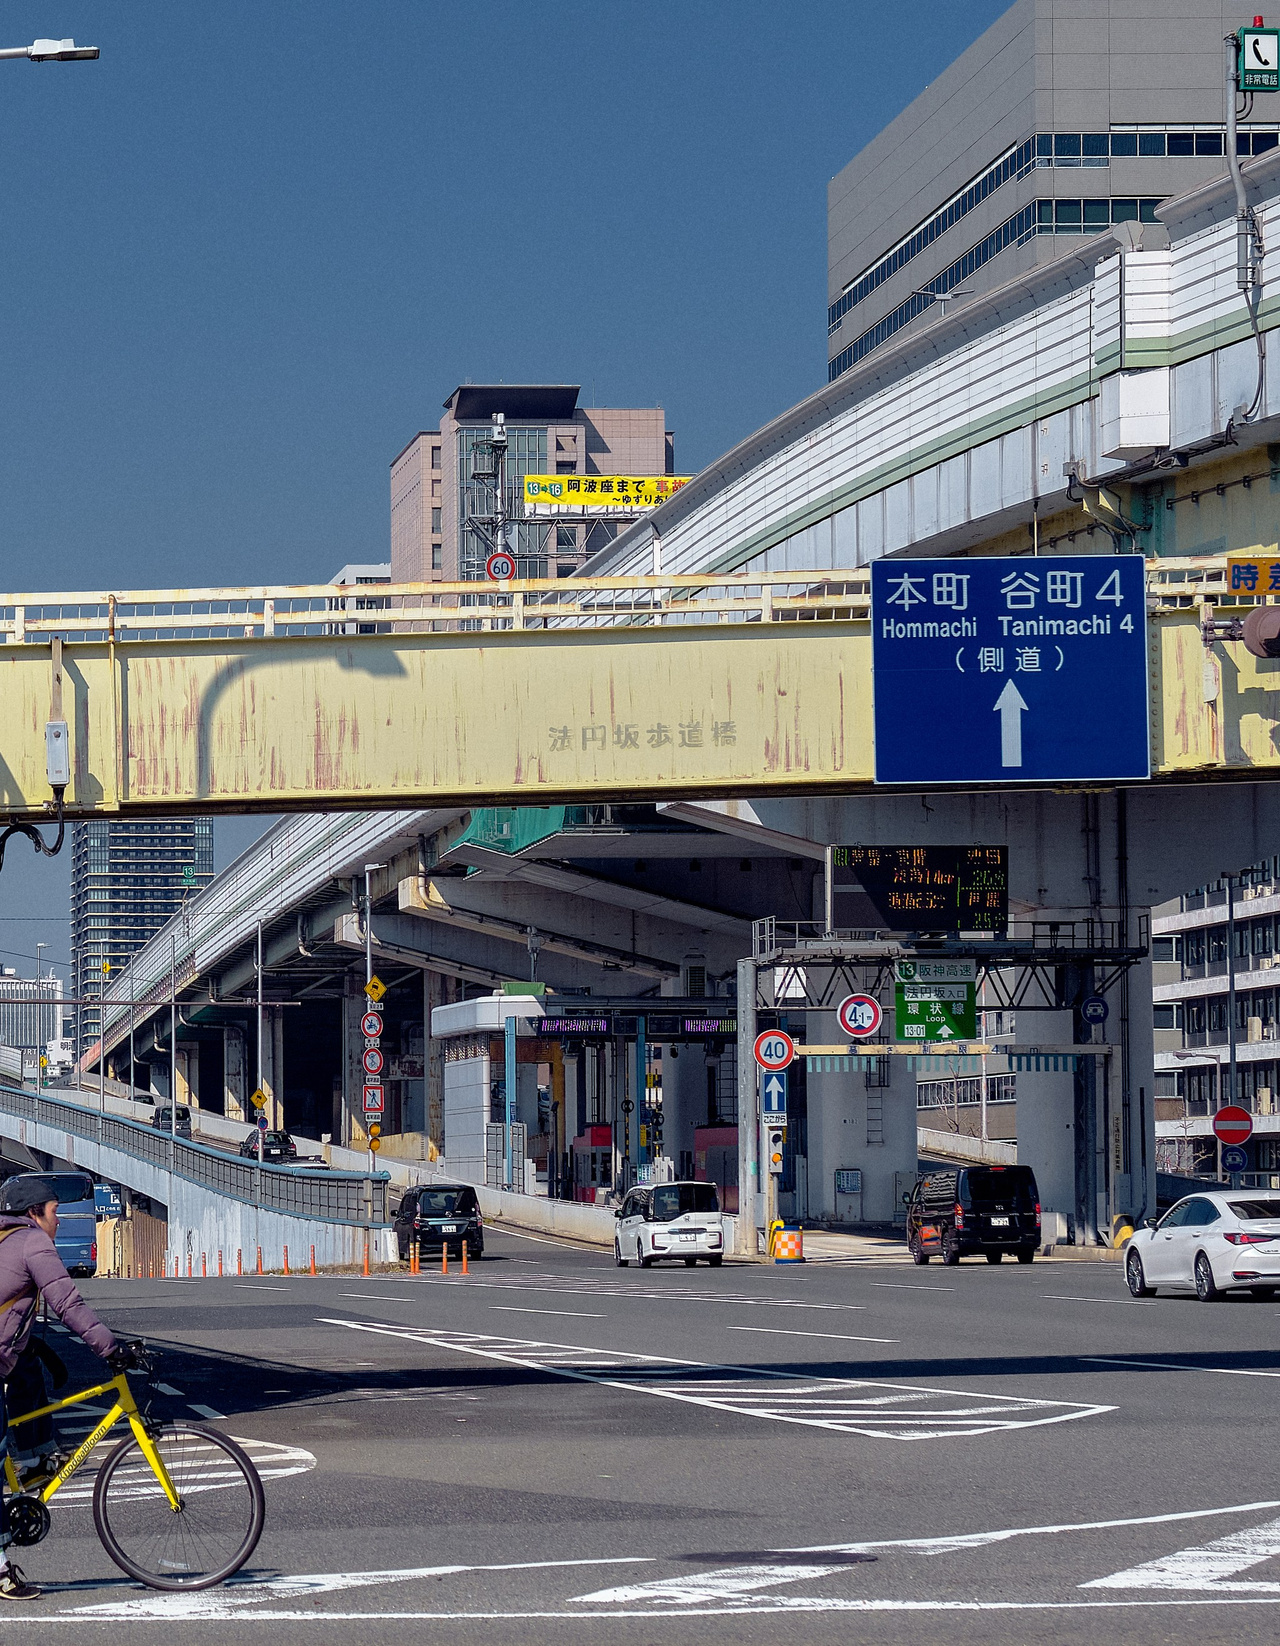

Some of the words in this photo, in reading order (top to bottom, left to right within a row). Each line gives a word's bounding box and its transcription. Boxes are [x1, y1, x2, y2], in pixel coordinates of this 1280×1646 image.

[1245, 74, 1277, 85] 非常電話
[528, 483, 539, 494] 13
[551, 484, 561, 496] 16
[567, 479, 645, 493] 阿波座まで
[493, 561, 509, 575] 60
[886, 572, 970, 611] 本町
[882, 617, 977, 638] Hommachi
[998, 614, 1111, 636] Tanimachi
[1120, 614, 1134, 634] 4
[549, 721, 737, 751] 法円坂歩道橋
[184, 867, 194, 875] 13
[900, 963, 914, 976] 13
[920, 964, 972, 977] 阪神高速
[907, 1002, 964, 1015] 環状線
[926, 1015, 946, 1023] Loop
[763, 1041, 785, 1059] 40
[764, 1115, 786, 1123] ここから
[58, 1425, 107, 1483] KhodaaBloom
